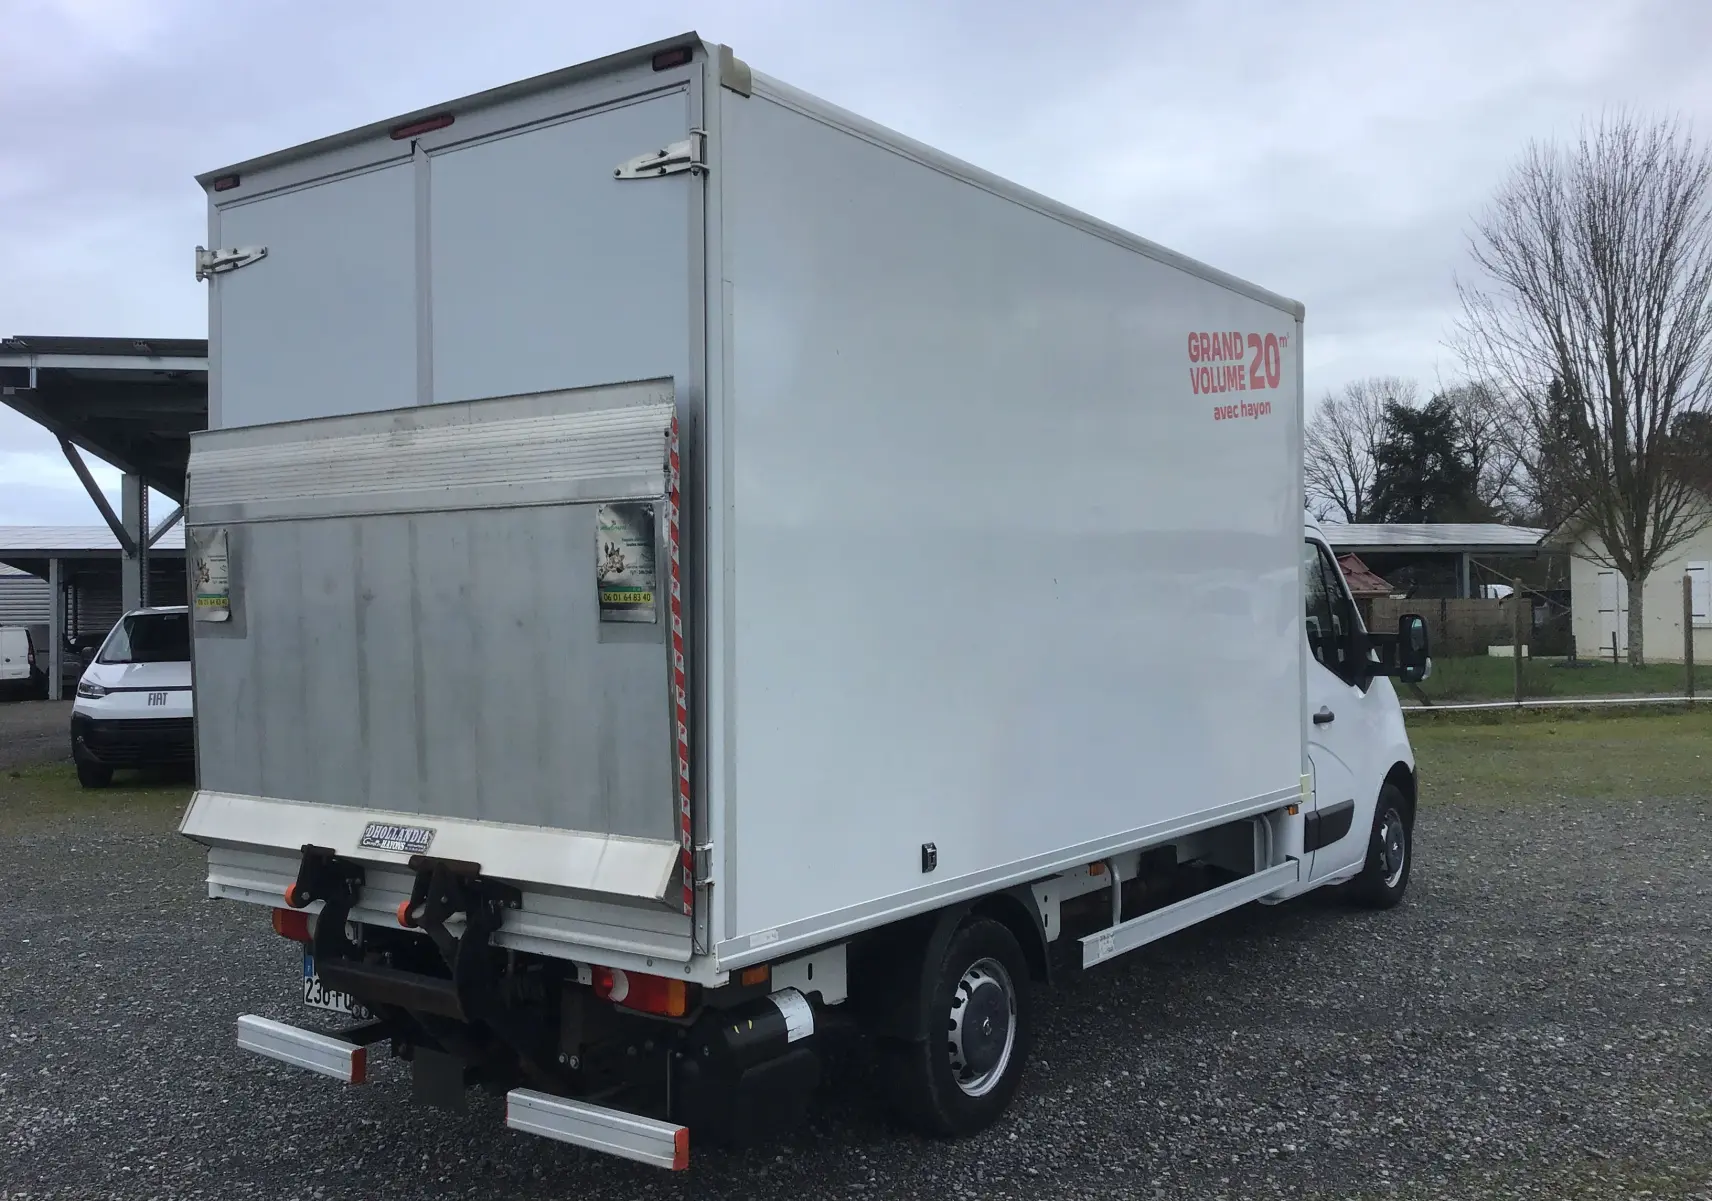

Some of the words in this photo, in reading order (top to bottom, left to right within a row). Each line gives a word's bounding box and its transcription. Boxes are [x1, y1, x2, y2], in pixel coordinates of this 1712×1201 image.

[1188, 332, 1244, 362] GRAND
[1190, 365, 1246, 394] VOLUME
[1214, 404, 1239, 420] avec
[1241, 400, 1271, 420] hayon
[604, 593, 612, 601] 06
[613, 593, 621, 601] 01
[624, 593, 632, 601] 64
[643, 593, 651, 602] 40
[148, 692, 168, 706] FIAT
[366, 824, 430, 844] DHOLLANDIA
[381, 840, 406, 850] HAYONS
